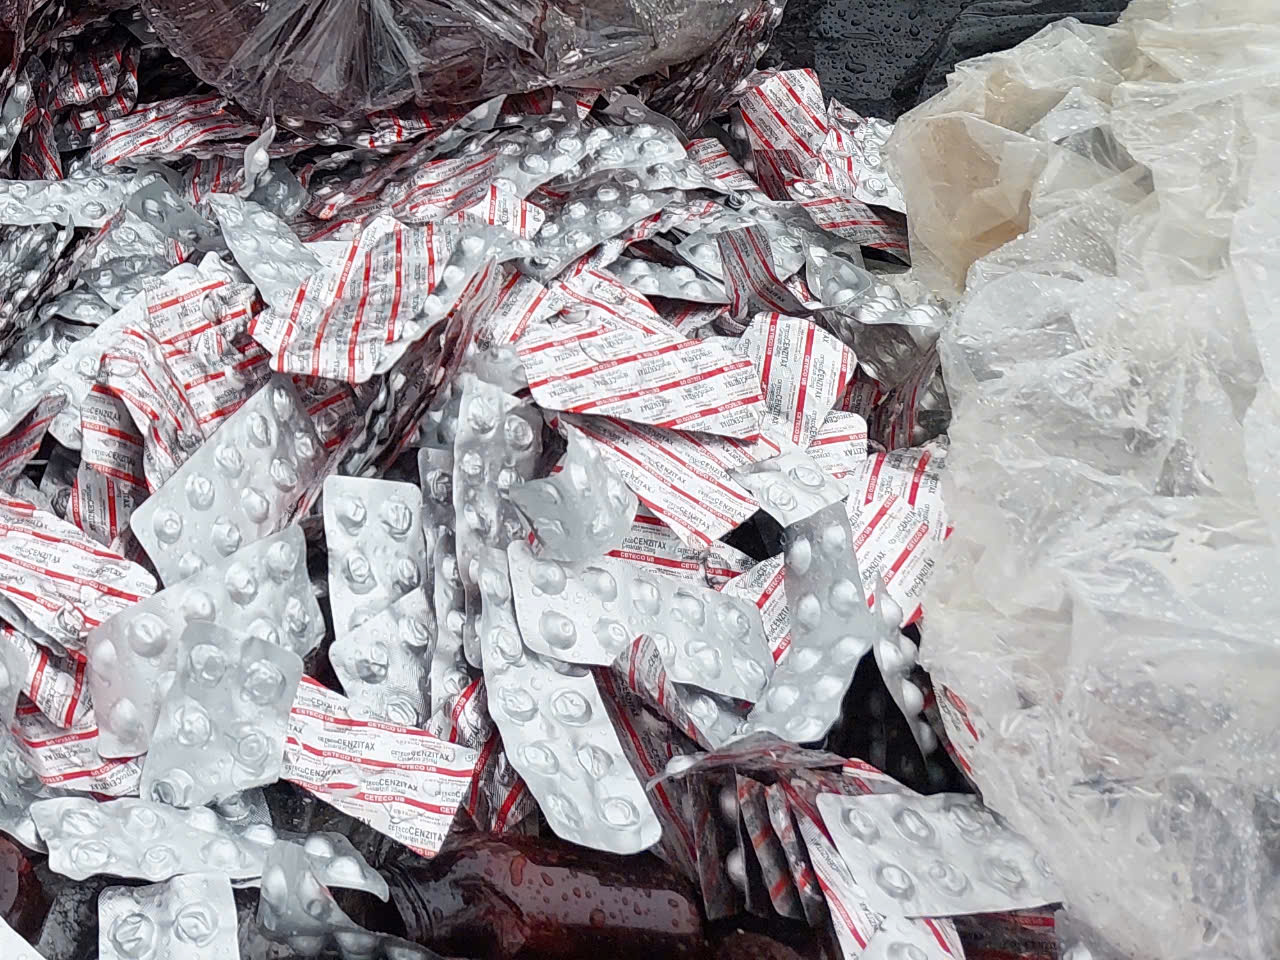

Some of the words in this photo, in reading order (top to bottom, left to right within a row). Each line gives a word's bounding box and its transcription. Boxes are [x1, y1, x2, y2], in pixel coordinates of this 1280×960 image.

[802, 355, 810, 380] CETECO
[663, 511, 685, 527] CETECO
[906, 530, 922, 551] CETECO
[367, 721, 396, 732] CETECO
[322, 751, 351, 761] CETECO
[364, 794, 393, 803] CETECO
